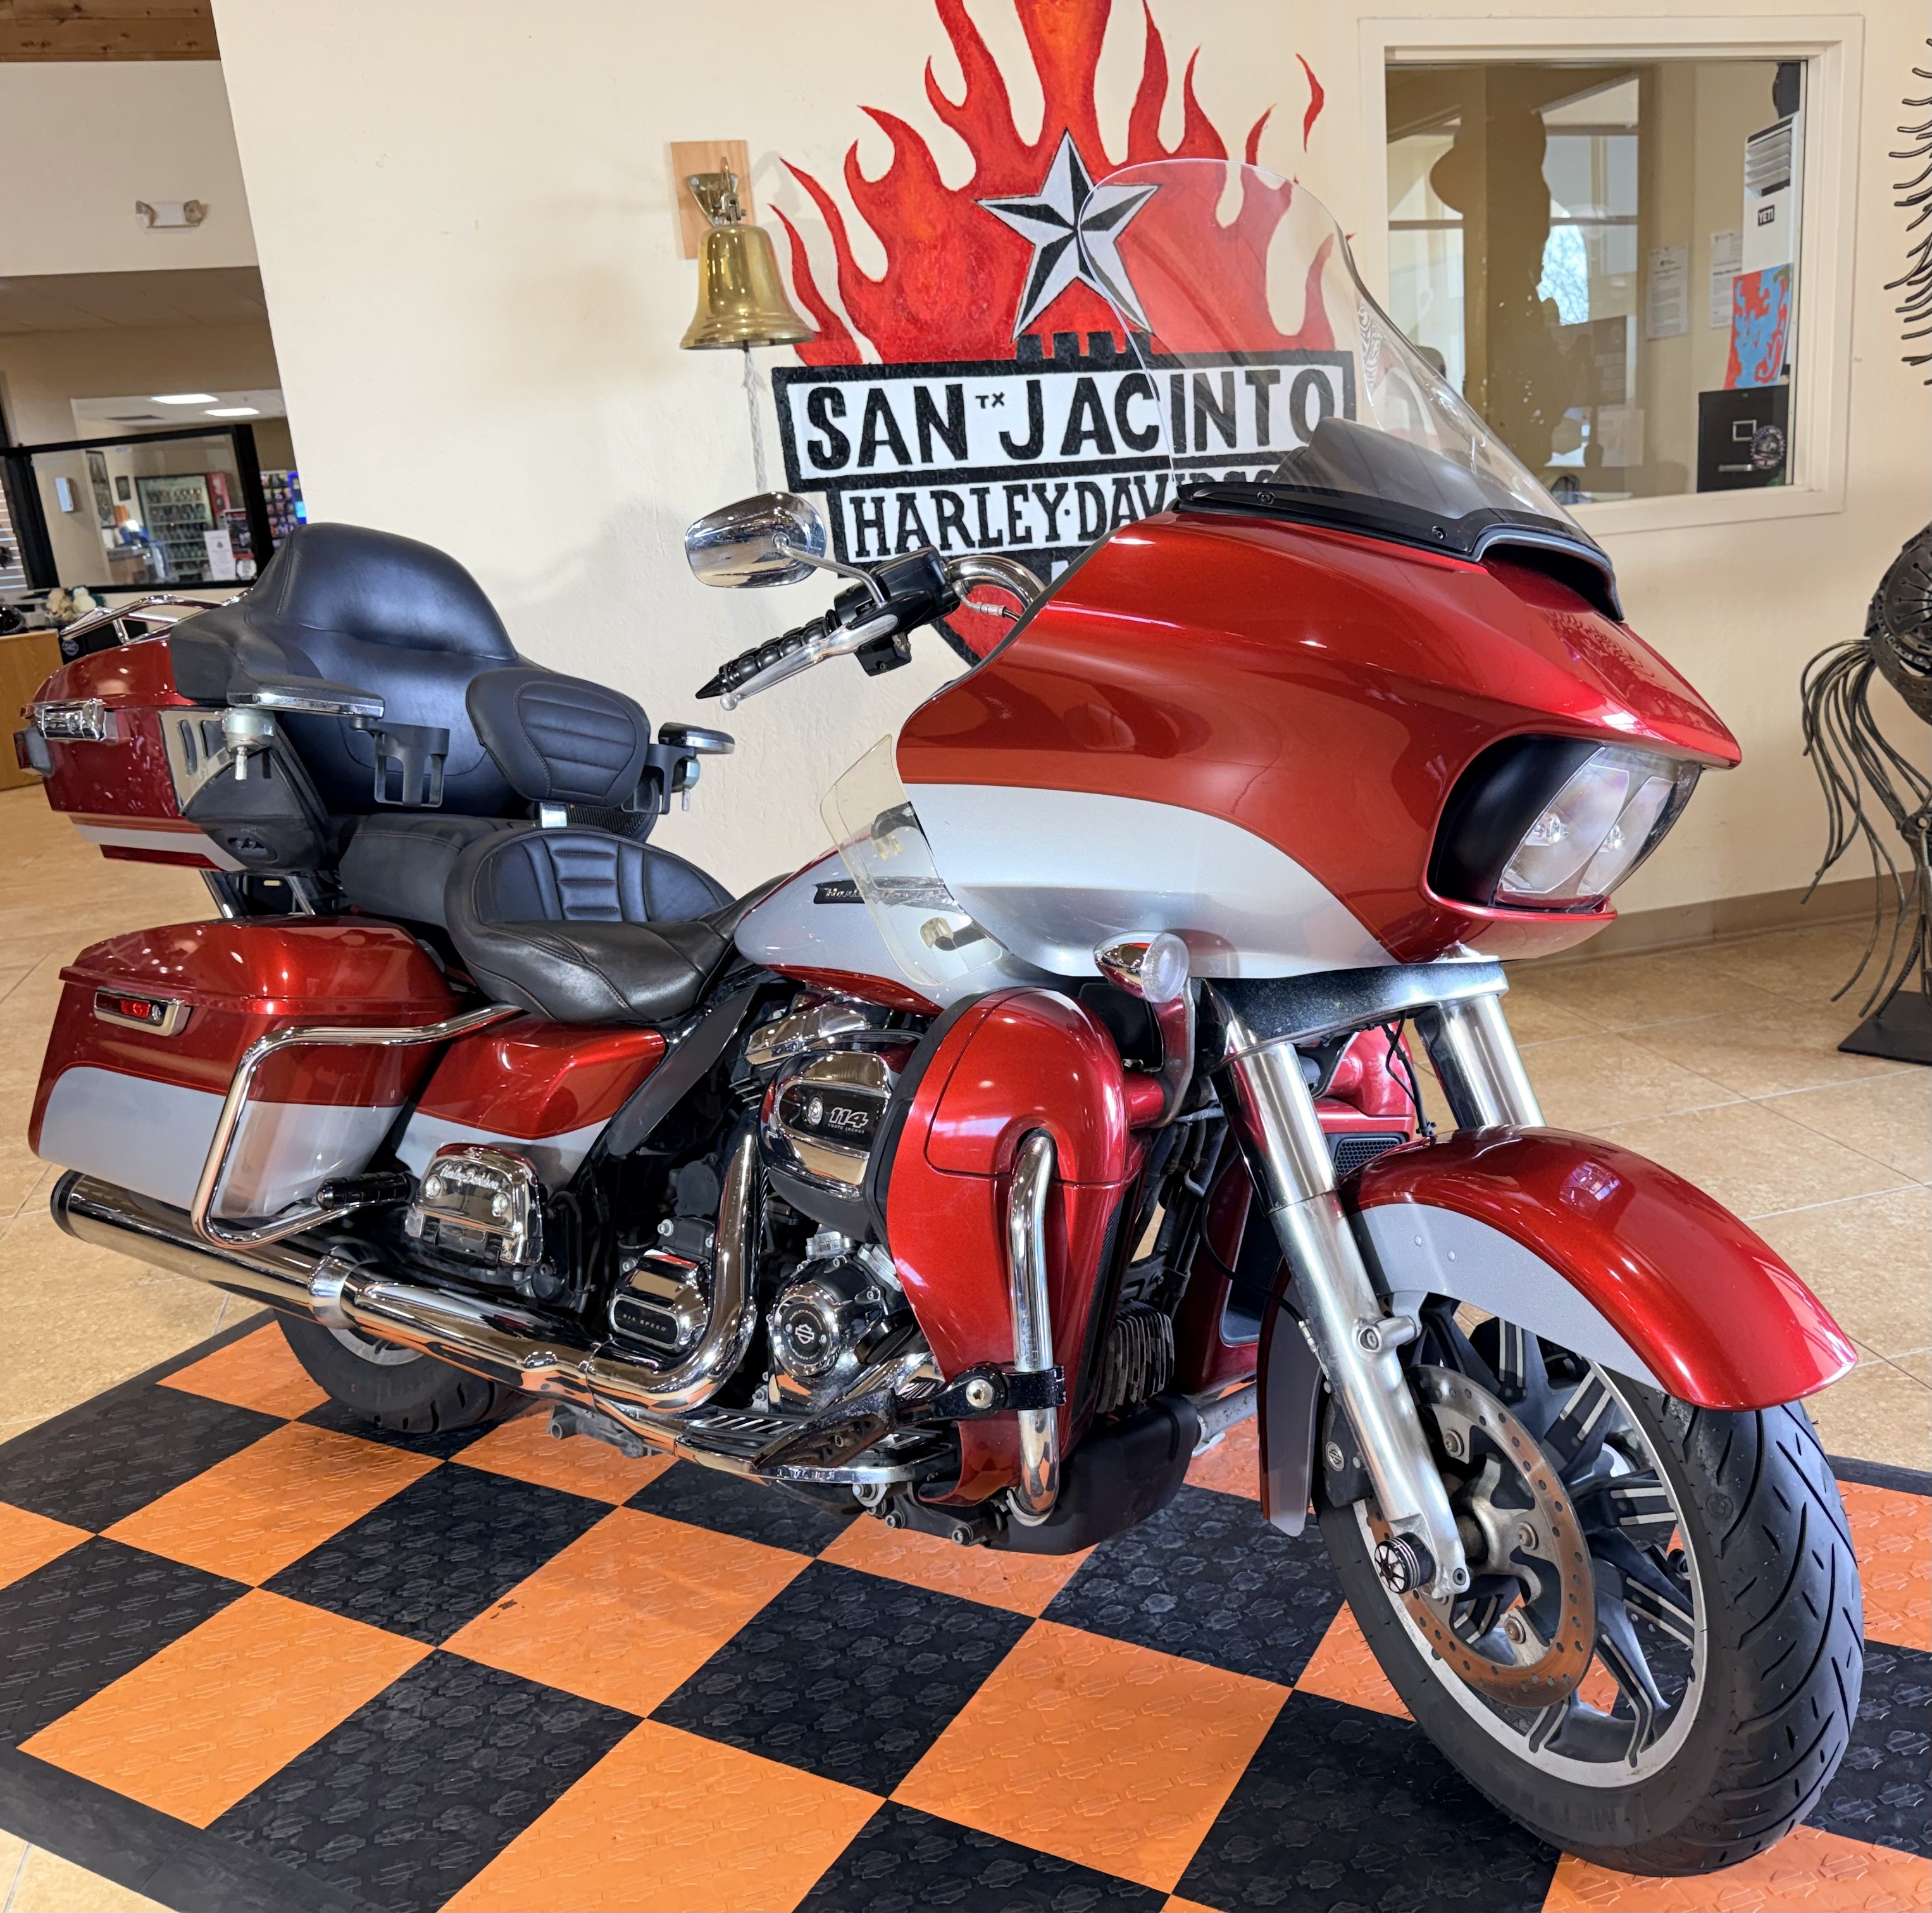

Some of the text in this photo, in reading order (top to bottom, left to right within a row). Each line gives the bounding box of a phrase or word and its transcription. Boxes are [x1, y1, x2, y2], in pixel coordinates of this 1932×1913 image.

[1758, 208, 1774, 225] YETI
[807, 368, 1335, 471] SAN TX JACINTO
[828, 1107, 869, 1129] 114
[623, 1313, 666, 1331] SIX SPEED
